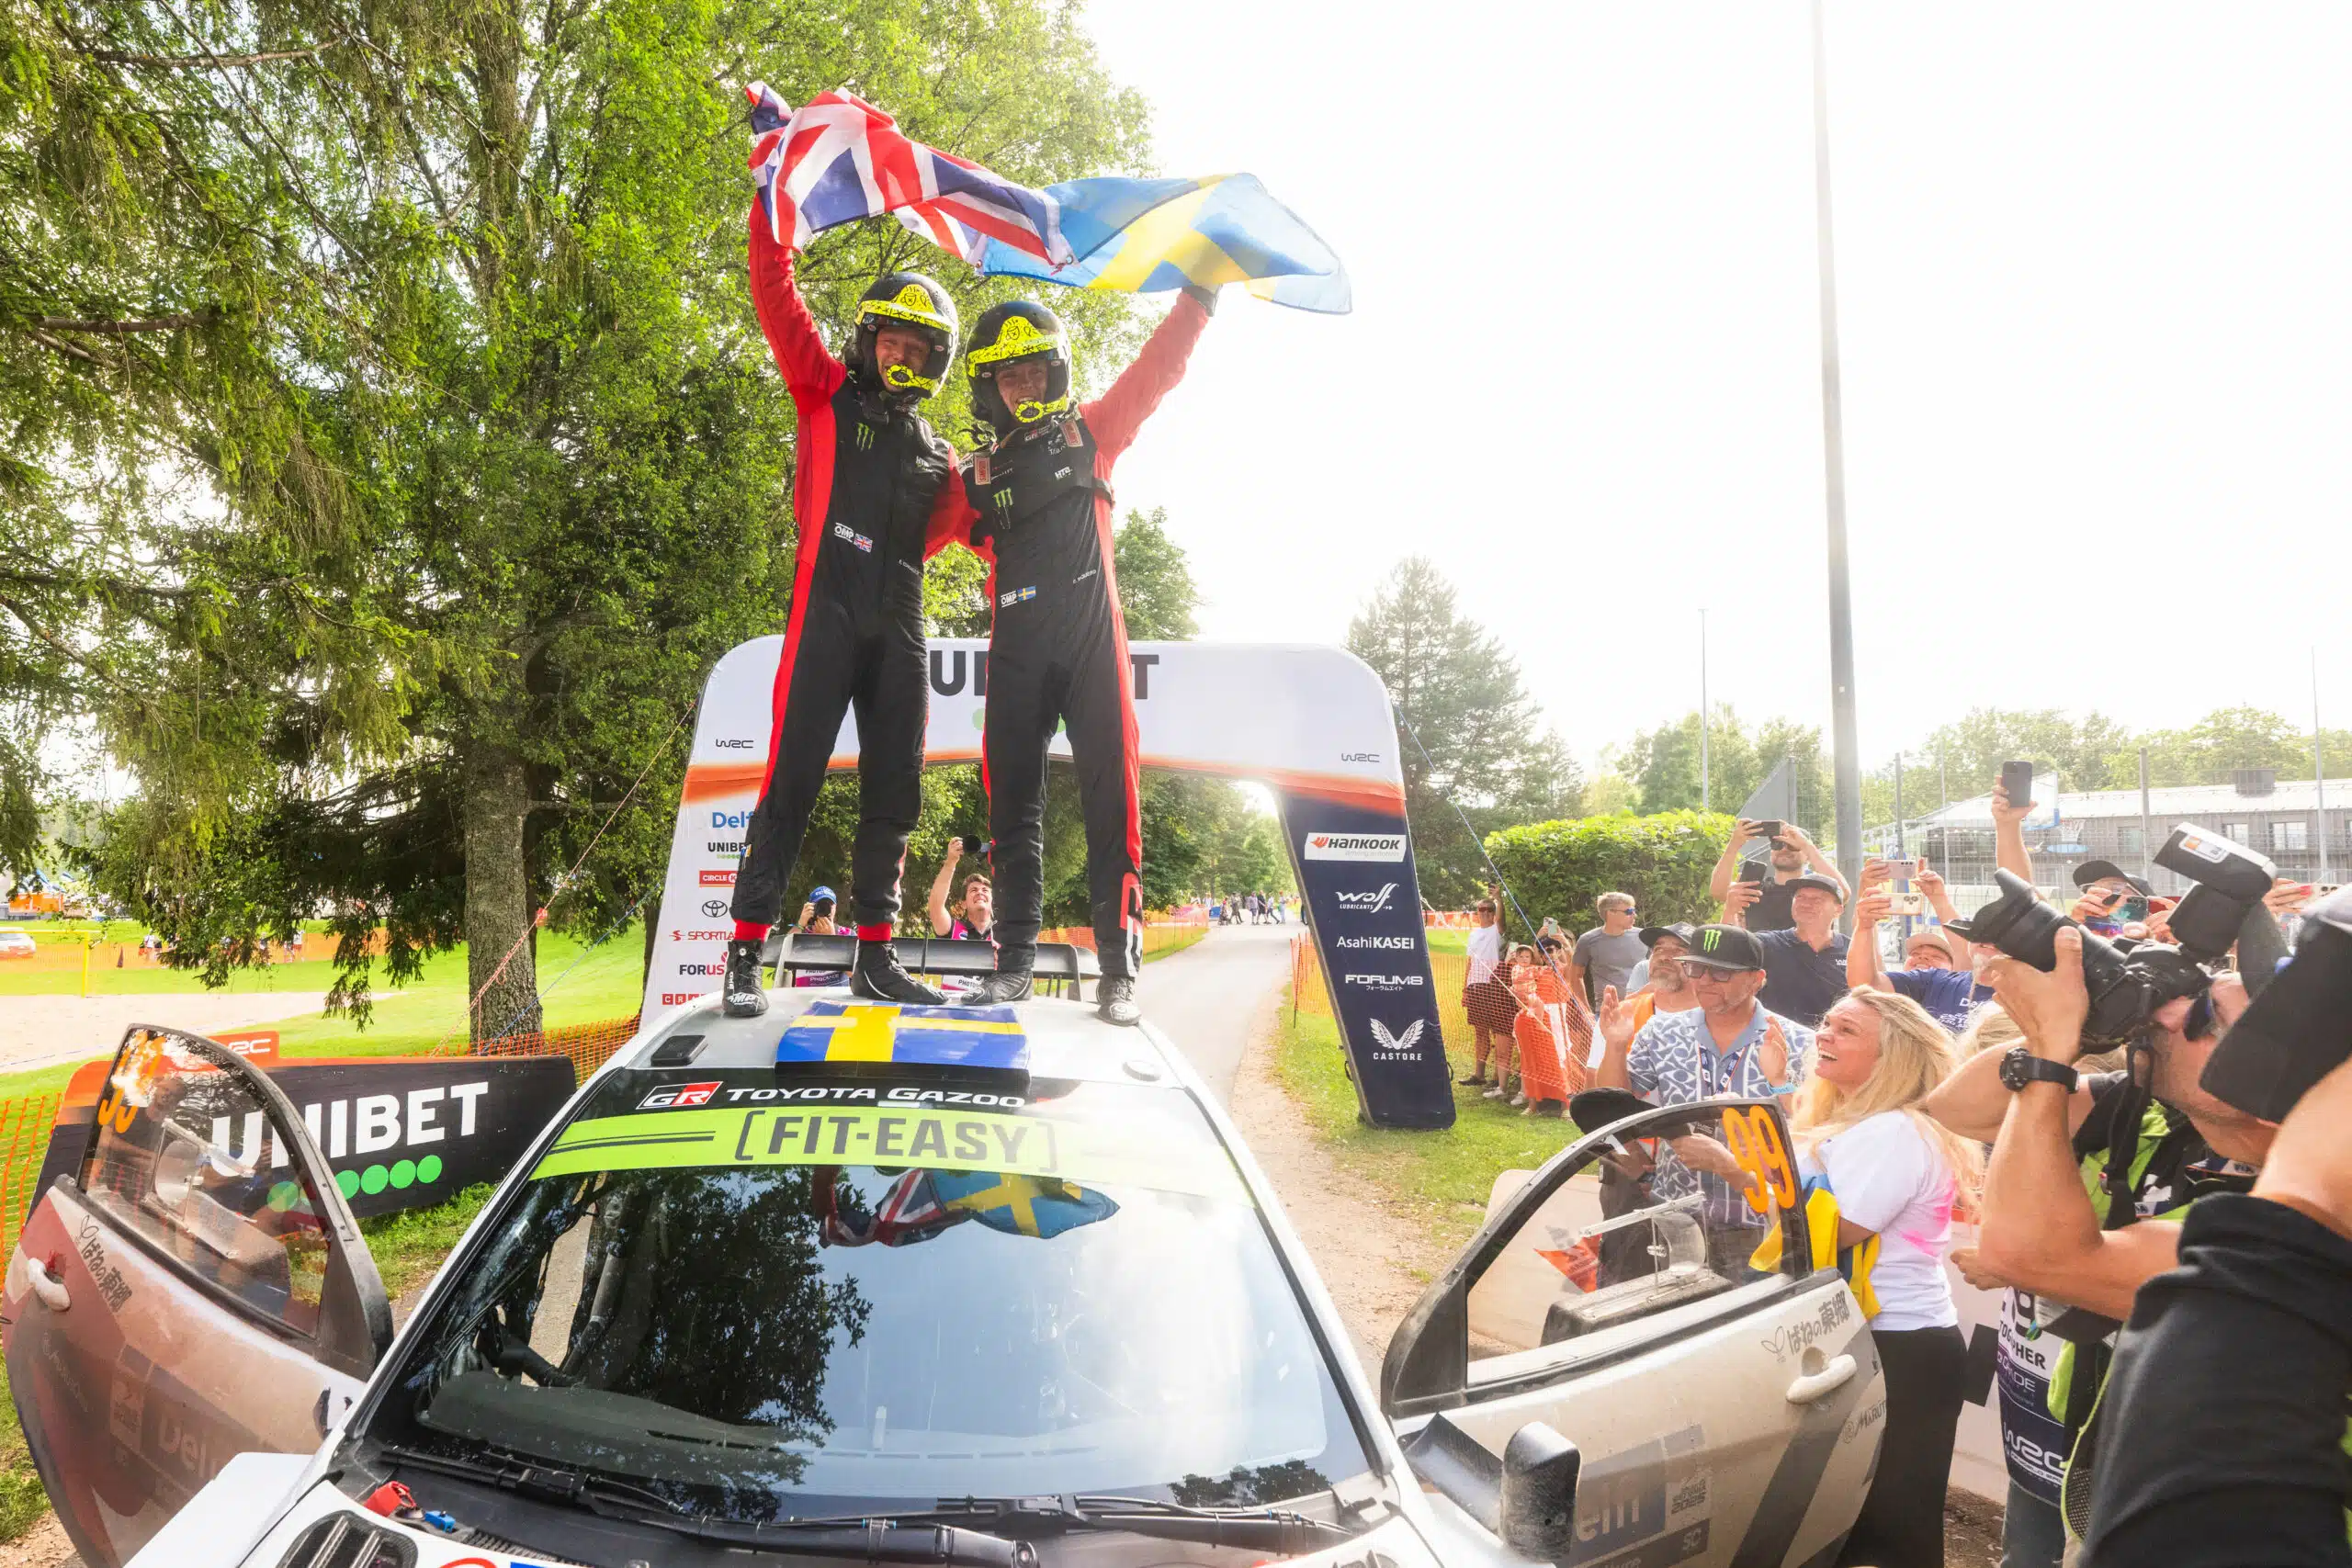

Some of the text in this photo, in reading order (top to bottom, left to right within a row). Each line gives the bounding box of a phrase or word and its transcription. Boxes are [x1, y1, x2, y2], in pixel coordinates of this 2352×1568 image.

[834, 525, 854, 540] OMP
[1001, 592, 1018, 605] OMP
[716, 739, 754, 749] WRC
[1341, 753, 1380, 763] WRC
[703, 874, 728, 882] CIRCLE
[679, 964, 725, 976] FORUS
[1345, 974, 1423, 986] FORUM8
[1374, 1053, 1422, 1061] CASTORE
[726, 1089, 876, 1101] TOYOTA
[887, 1088, 1025, 1108] GAZOO
[1722, 1105, 1795, 1213] 99
[1786, 1290, 1850, 1357] ばねの東郷
